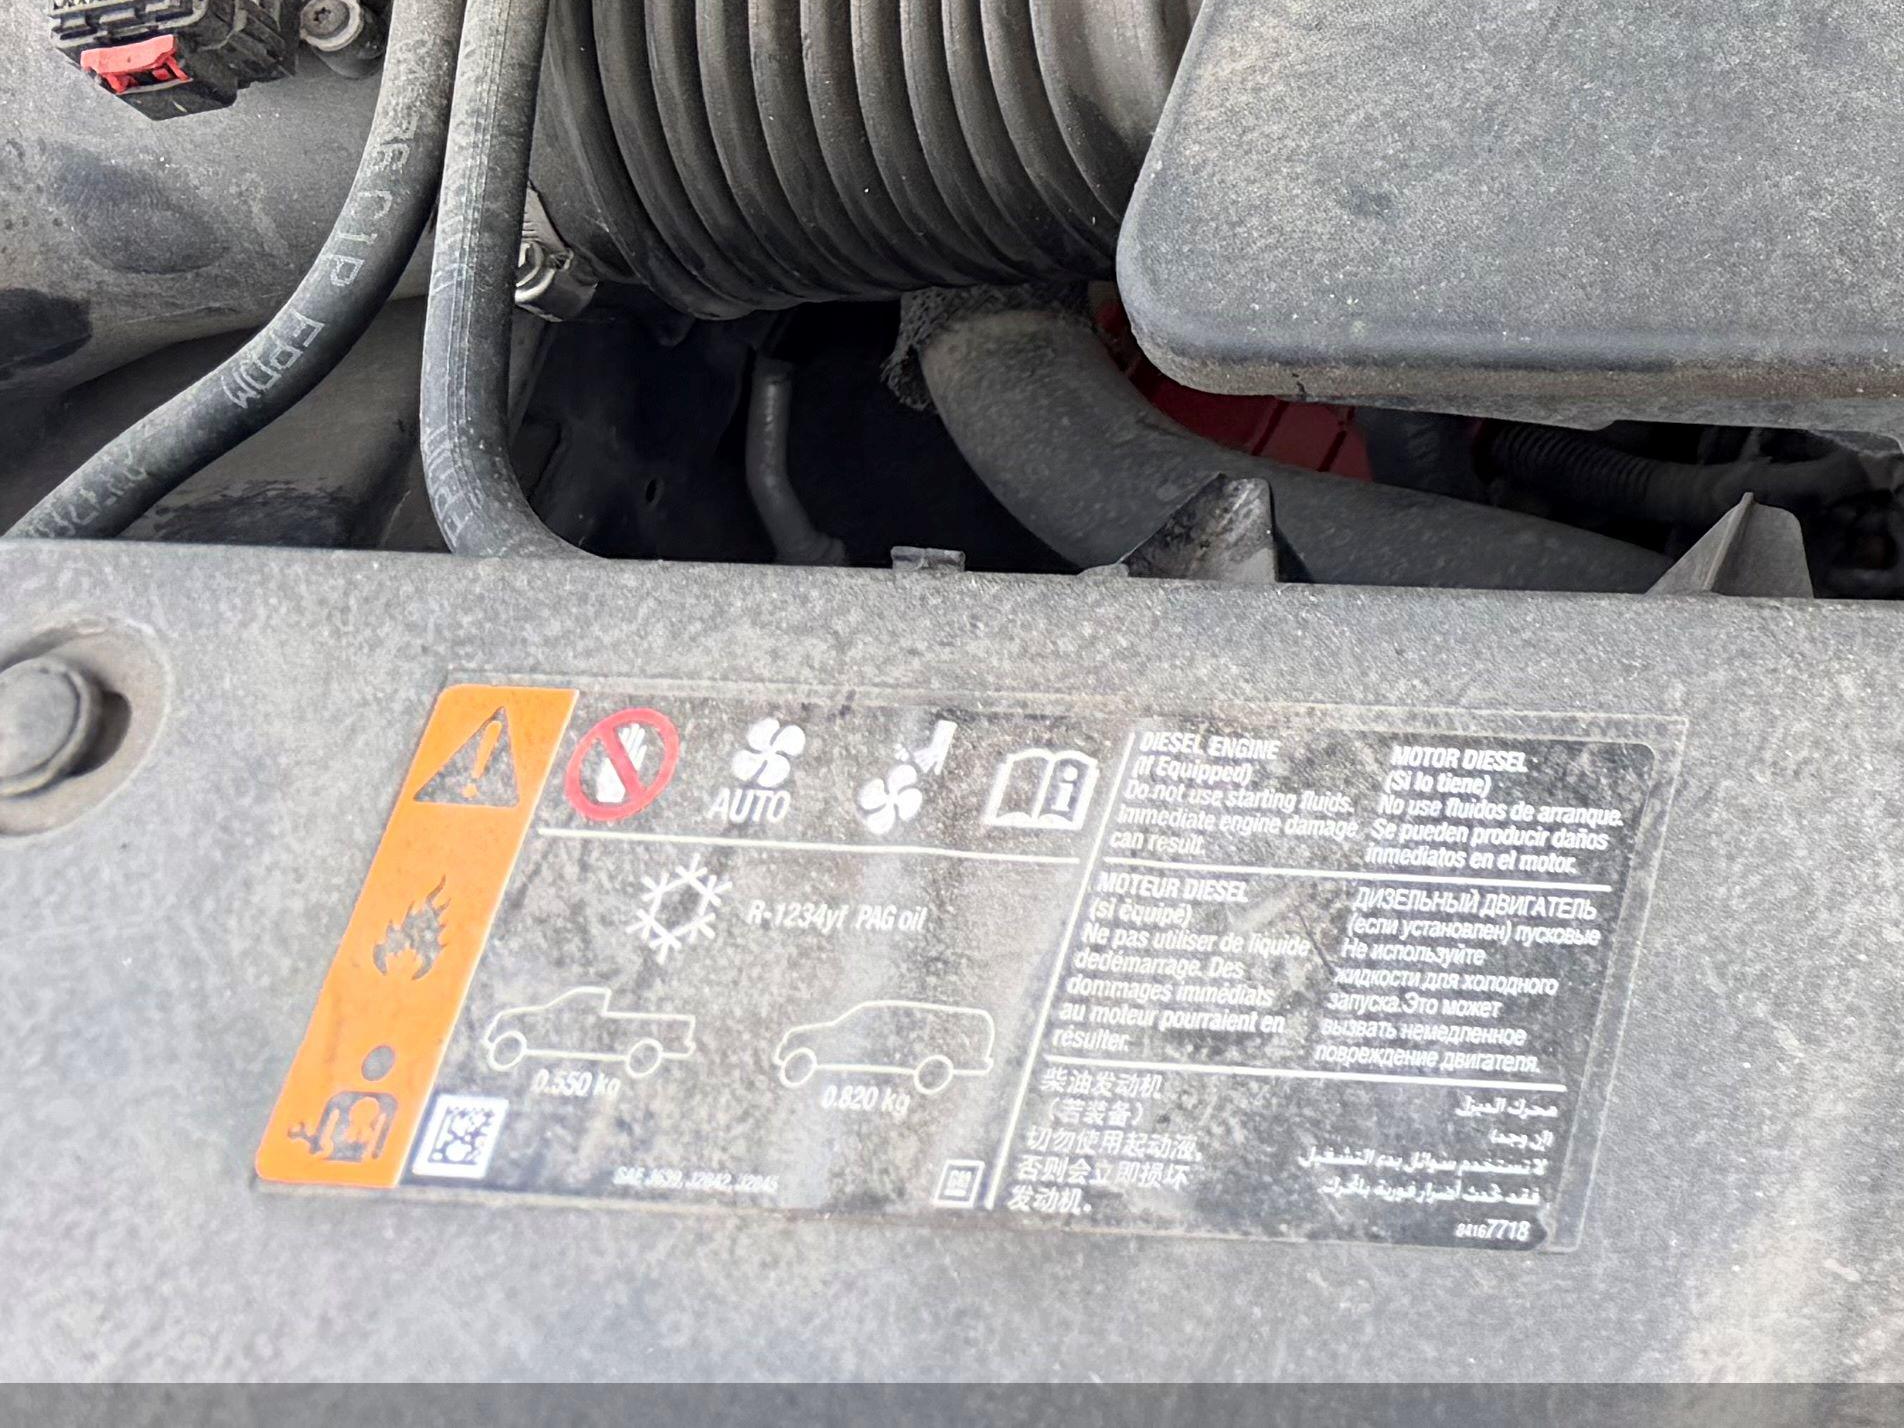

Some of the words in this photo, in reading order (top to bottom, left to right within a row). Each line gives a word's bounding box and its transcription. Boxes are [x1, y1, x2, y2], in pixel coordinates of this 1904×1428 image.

[221, 310, 327, 410] EPDM
[1139, 731, 1204, 755] DIESEL
[1207, 734, 1281, 760] ENGINE
[1390, 745, 1461, 770] MOTOR
[1462, 747, 1529, 773] DIESEL
[1156, 759, 1254, 785] Equipped)
[1384, 769, 1412, 794] (Si
[1414, 771, 1434, 793] lo
[1436, 772, 1492, 798] tiene)
[705, 787, 792, 824] AUTO
[1123, 779, 1149, 801] Do
[1150, 783, 1187, 803] not
[1189, 789, 1223, 808] use
[1224, 786, 1297, 813] starting
[1299, 789, 1355, 815] fluids.
[1378, 794, 1406, 816] No
[1407, 798, 1442, 817] use
[1444, 797, 1507, 821] fluidos
[1509, 800, 1536, 823] de
[1537, 805, 1625, 830] arranque.
[1117, 803, 1217, 832] Immediate
[1218, 814, 1283, 840] engine
[1285, 814, 1361, 842] damage
[1370, 817, 1397, 839] Se
[1398, 820, 1469, 844] pueden
[1470, 823, 1551, 848] producir
[1552, 828, 1610, 851] daños
[1109, 830, 1145, 849] can
[1147, 832, 1207, 856] result.
[1469, 852, 1496, 871] en
[1497, 849, 1517, 871] el
[1518, 853, 1578, 875] motor.
[1097, 871, 1182, 898] MOTEUR
[1183, 877, 1249, 903] DIESEL
[747, 898, 850, 936] R-1234yf
[855, 903, 897, 931] PAG
[898, 906, 929, 932] oil
[1090, 897, 1116, 921] (si
[1117, 901, 1193, 928] équipé)
[1352, 886, 1481, 914] ДИЗЕЛЬНЫЙ
[1478, 894, 1599, 921] ДВИГАТЕЛЬ
[1081, 922, 1110, 945] Ne
[1112, 927, 1150, 951] pas
[1152, 929, 1219, 953] utiliser
[1219, 932, 1245, 953] de
[1246, 933, 1311, 958] liquide
[1347, 913, 1400, 937] (если
[1399, 918, 1513, 946] установлен)
[1514, 927, 1602, 948] пусковые
[1208, 956, 1246, 980] Des
[1339, 937, 1369, 959] Не
[1369, 943, 1488, 969] используйте
[1066, 974, 1173, 1005] dommages
[1175, 981, 1279, 1009] immédiats
[1424, 971, 1460, 993] для
[1462, 975, 1560, 996] холодного
[1058, 1002, 1088, 1022] au
[1088, 1004, 1160, 1028] moteur
[1158, 1008, 1259, 1034] pourraient
[1258, 1014, 1287, 1034] en
[1440, 998, 1504, 1020] может
[1039, 1065, 1164, 1100] 柴油发动机
[1016, 1153, 1192, 1191] 否则会立即损坏
[1455, 1217, 1533, 1242] 84167718
